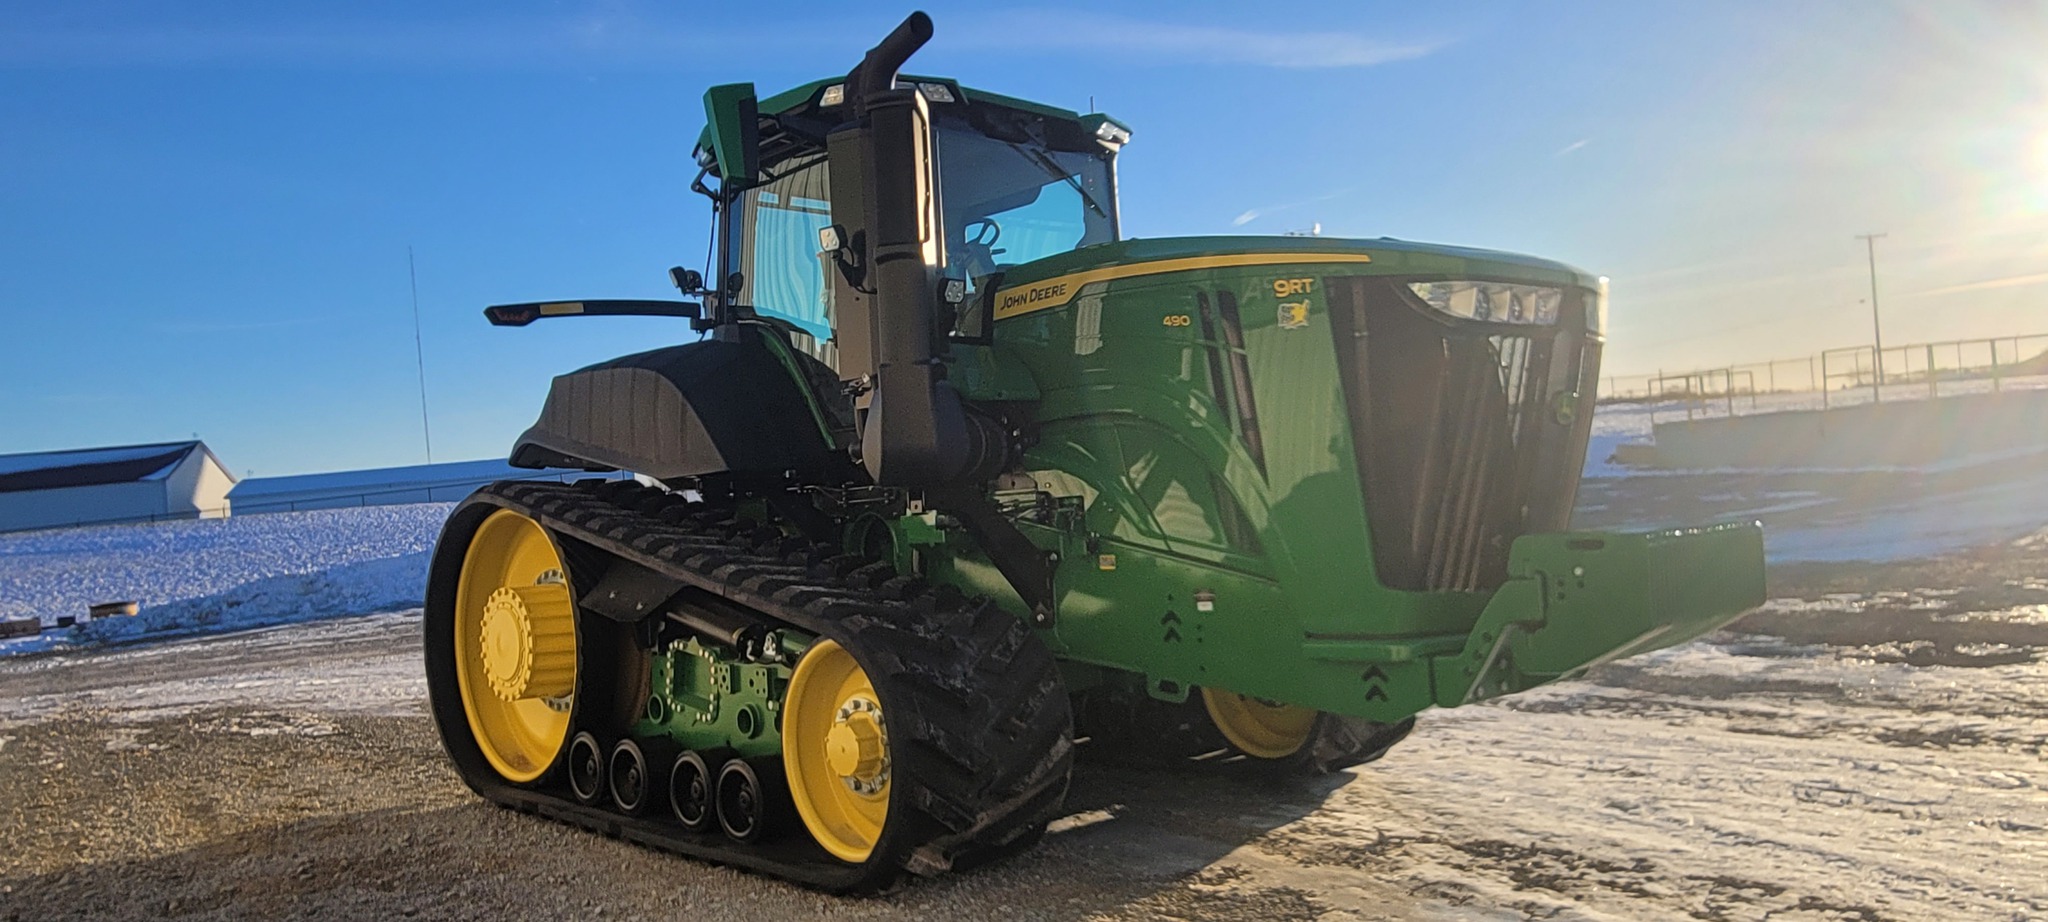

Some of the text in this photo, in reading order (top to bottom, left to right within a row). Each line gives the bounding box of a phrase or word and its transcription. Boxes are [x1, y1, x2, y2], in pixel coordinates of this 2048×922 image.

[1000, 283, 1067, 311] JOHN DEERE
[1273, 278, 1314, 298] 9RT
[1163, 315, 1191, 326] 490
